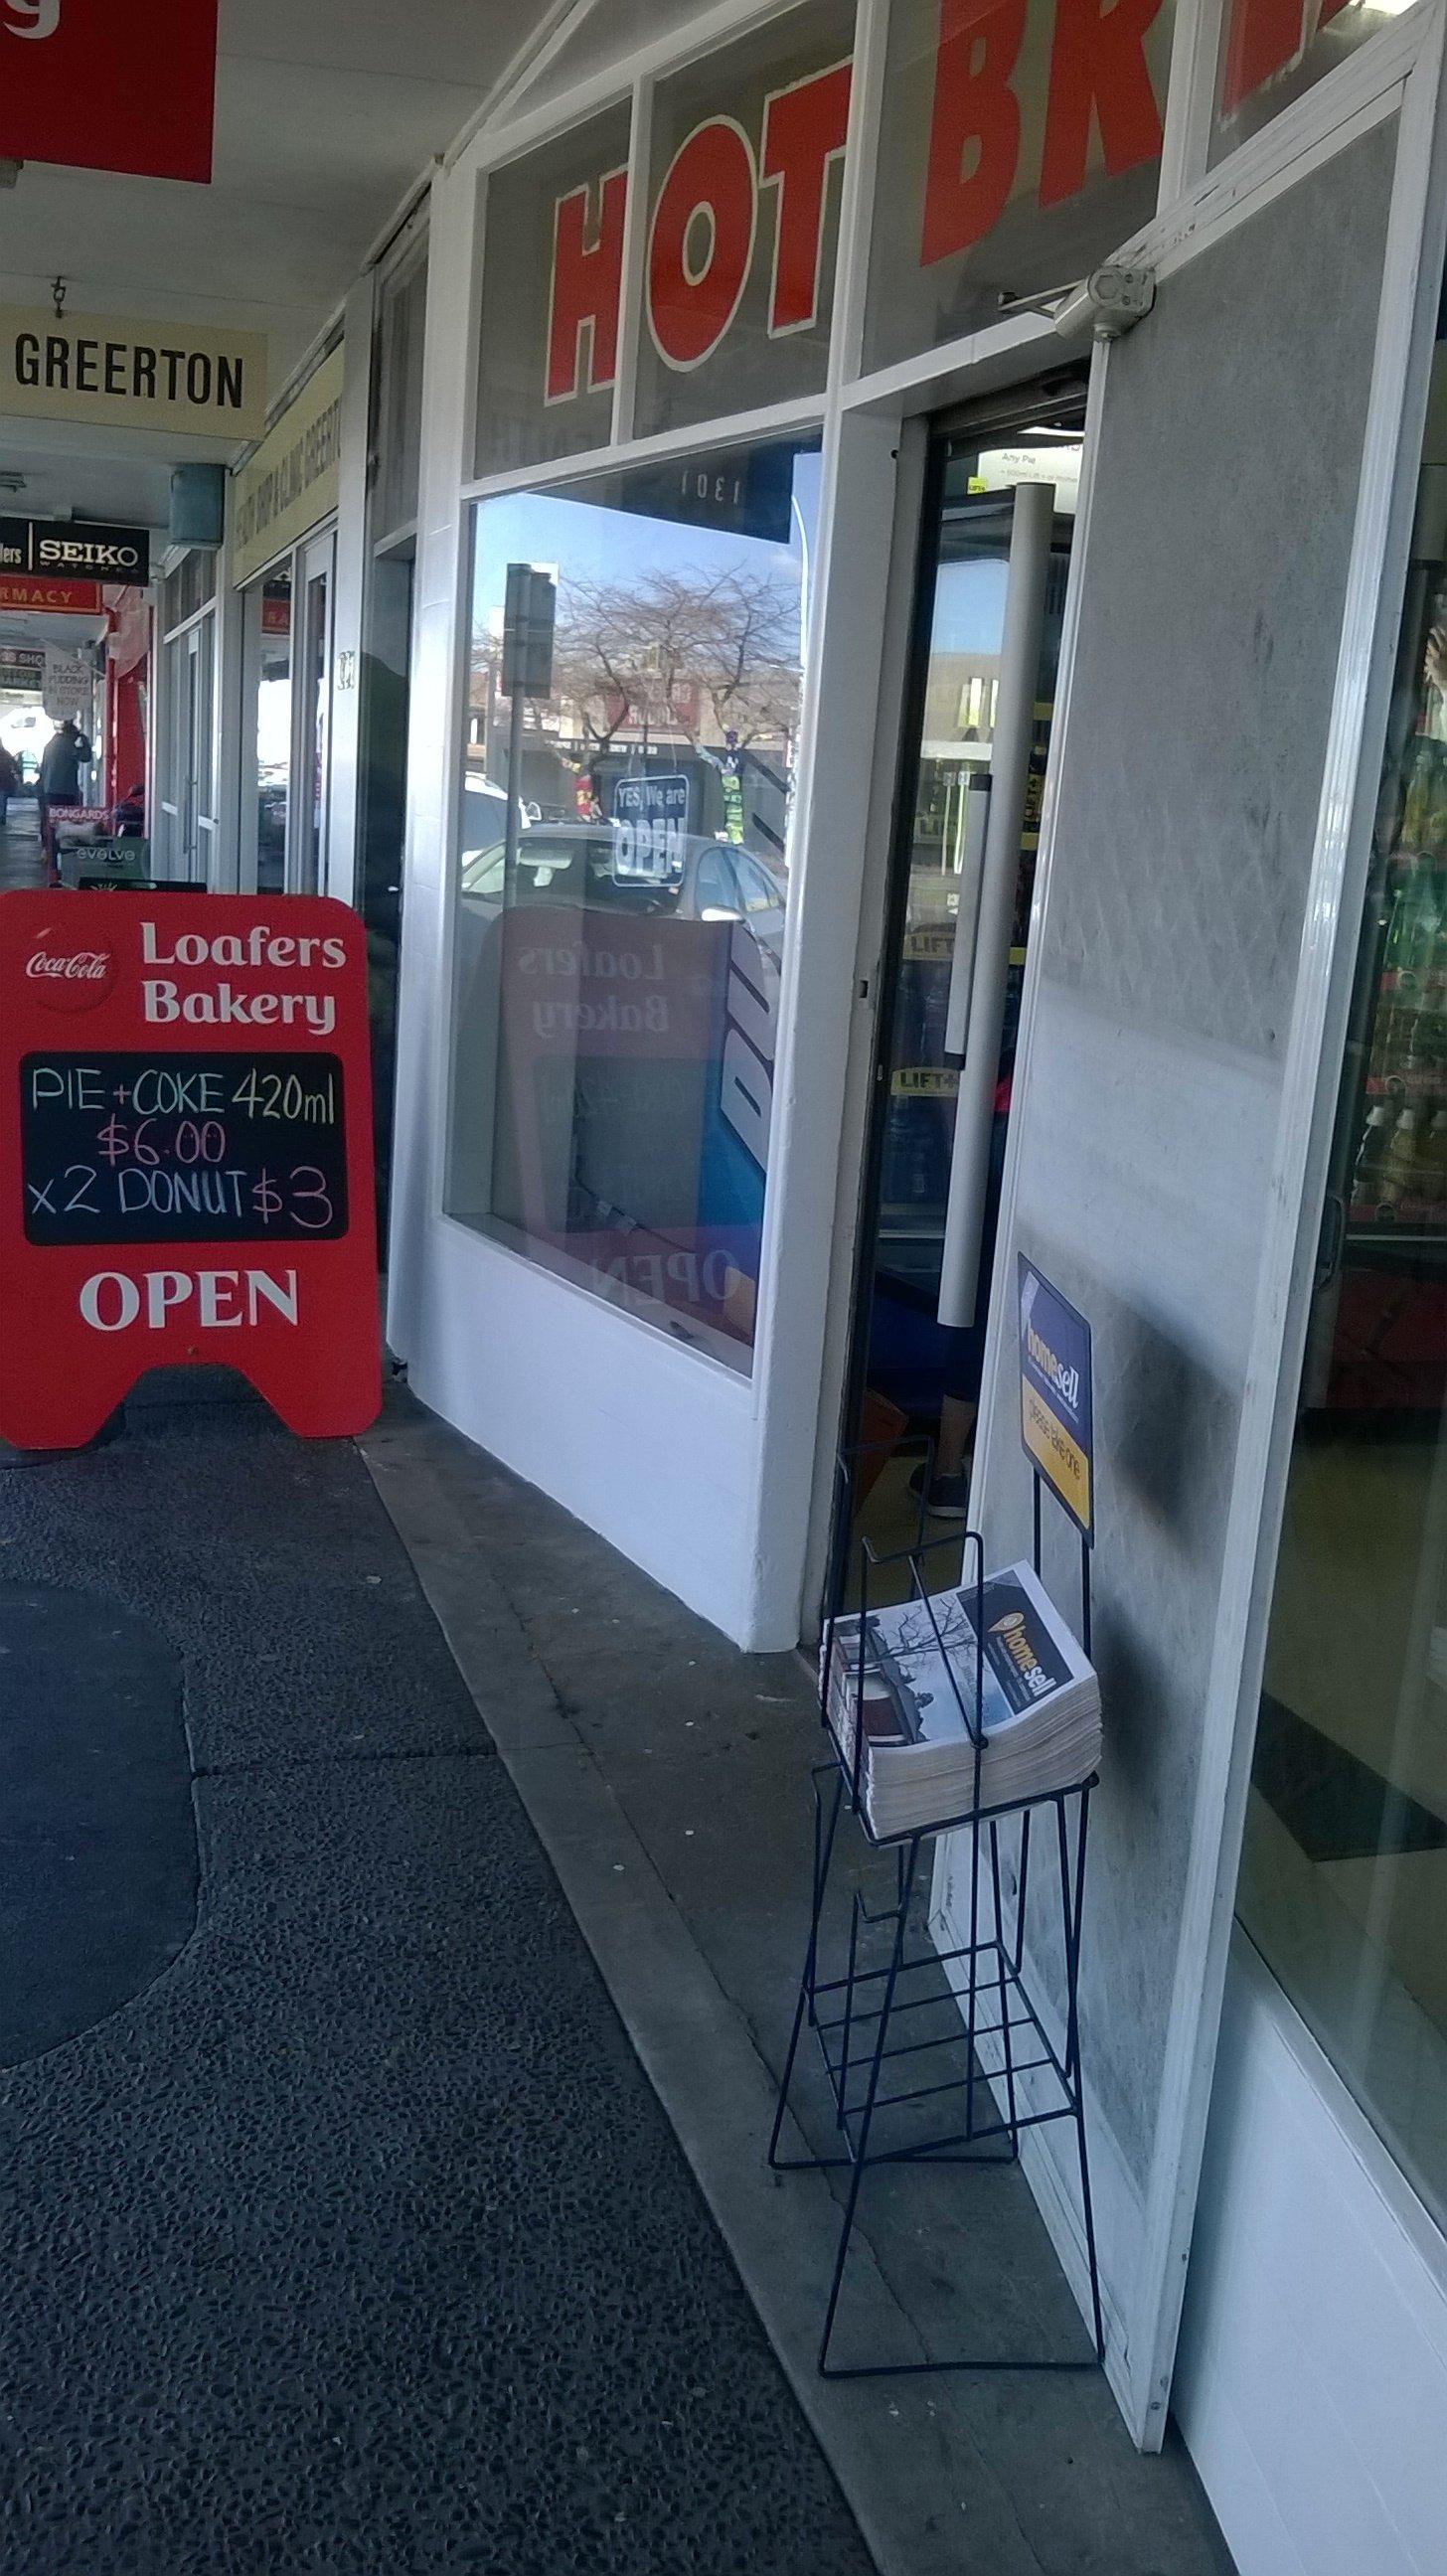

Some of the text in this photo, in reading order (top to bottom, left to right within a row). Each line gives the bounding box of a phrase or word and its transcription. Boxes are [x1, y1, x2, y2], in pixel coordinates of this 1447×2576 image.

[545, 54, 854, 407] HOT
[15, 333, 243, 408] GREERTON
[40, 538, 139, 567] SEIKO
[646, 785, 664, 807] We
[666, 788, 686, 805] are
[615, 817, 686, 876] OPEN
[25, 921, 347, 980] Coca-Cola Loafers
[141, 979, 337, 1036] Bakery
[33, 1067, 106, 1113] PIE
[232, 1068, 335, 1125] 420ml
[96, 1112, 227, 1167] $6.00
[118, 1168, 247, 1217] DONUT
[251, 1165, 333, 1229] $3
[79, 1269, 298, 1332] OPEN
[1027, 1327, 1080, 1409] homesell
[1003, 1625, 1057, 1697] homesell
